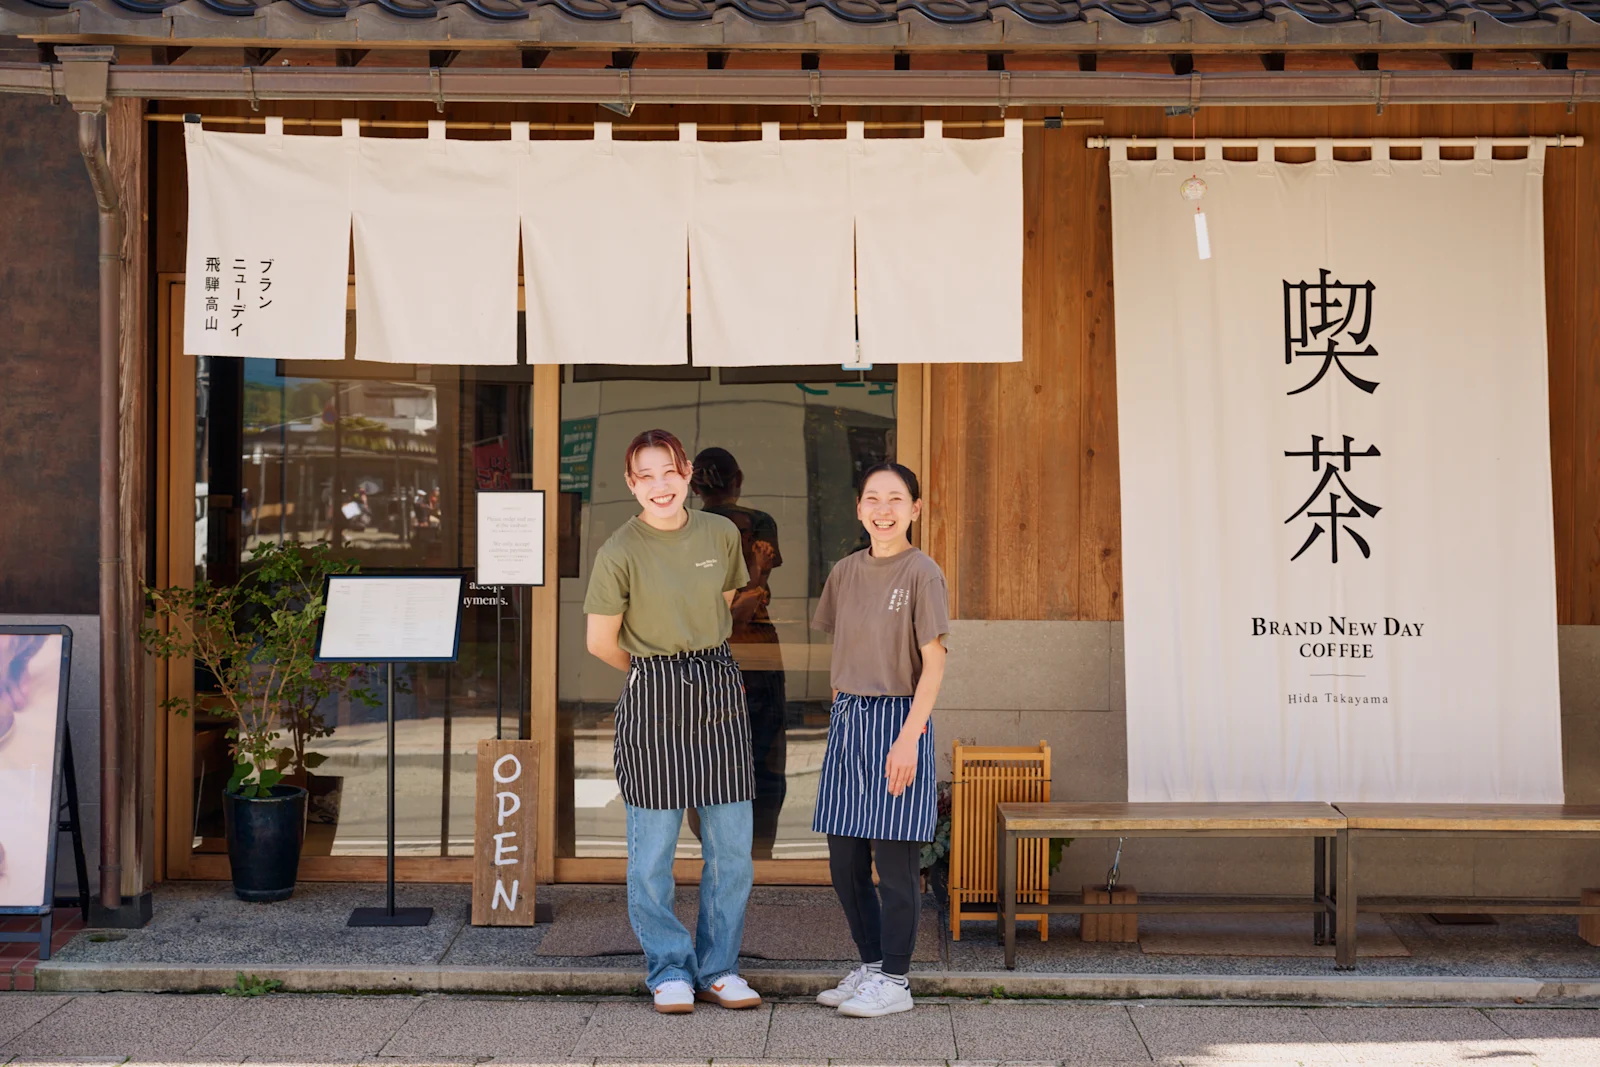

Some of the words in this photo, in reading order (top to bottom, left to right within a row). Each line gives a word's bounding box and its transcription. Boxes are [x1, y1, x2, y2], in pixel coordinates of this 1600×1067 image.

[205, 256, 221, 331] 飛騨高山
[230, 258, 247, 337] ニューデイ
[259, 258, 275, 309] ブラン
[1282, 267, 1382, 564] 喫茶
[1251, 617, 1323, 636] BRAND
[1328, 616, 1377, 636] NEW
[1383, 617, 1425, 637] DAY
[1299, 642, 1374, 659] COFFEE
[1288, 693, 1318, 704] Hida
[1324, 693, 1389, 706] Takayama
[491, 753, 522, 912] OPEN
